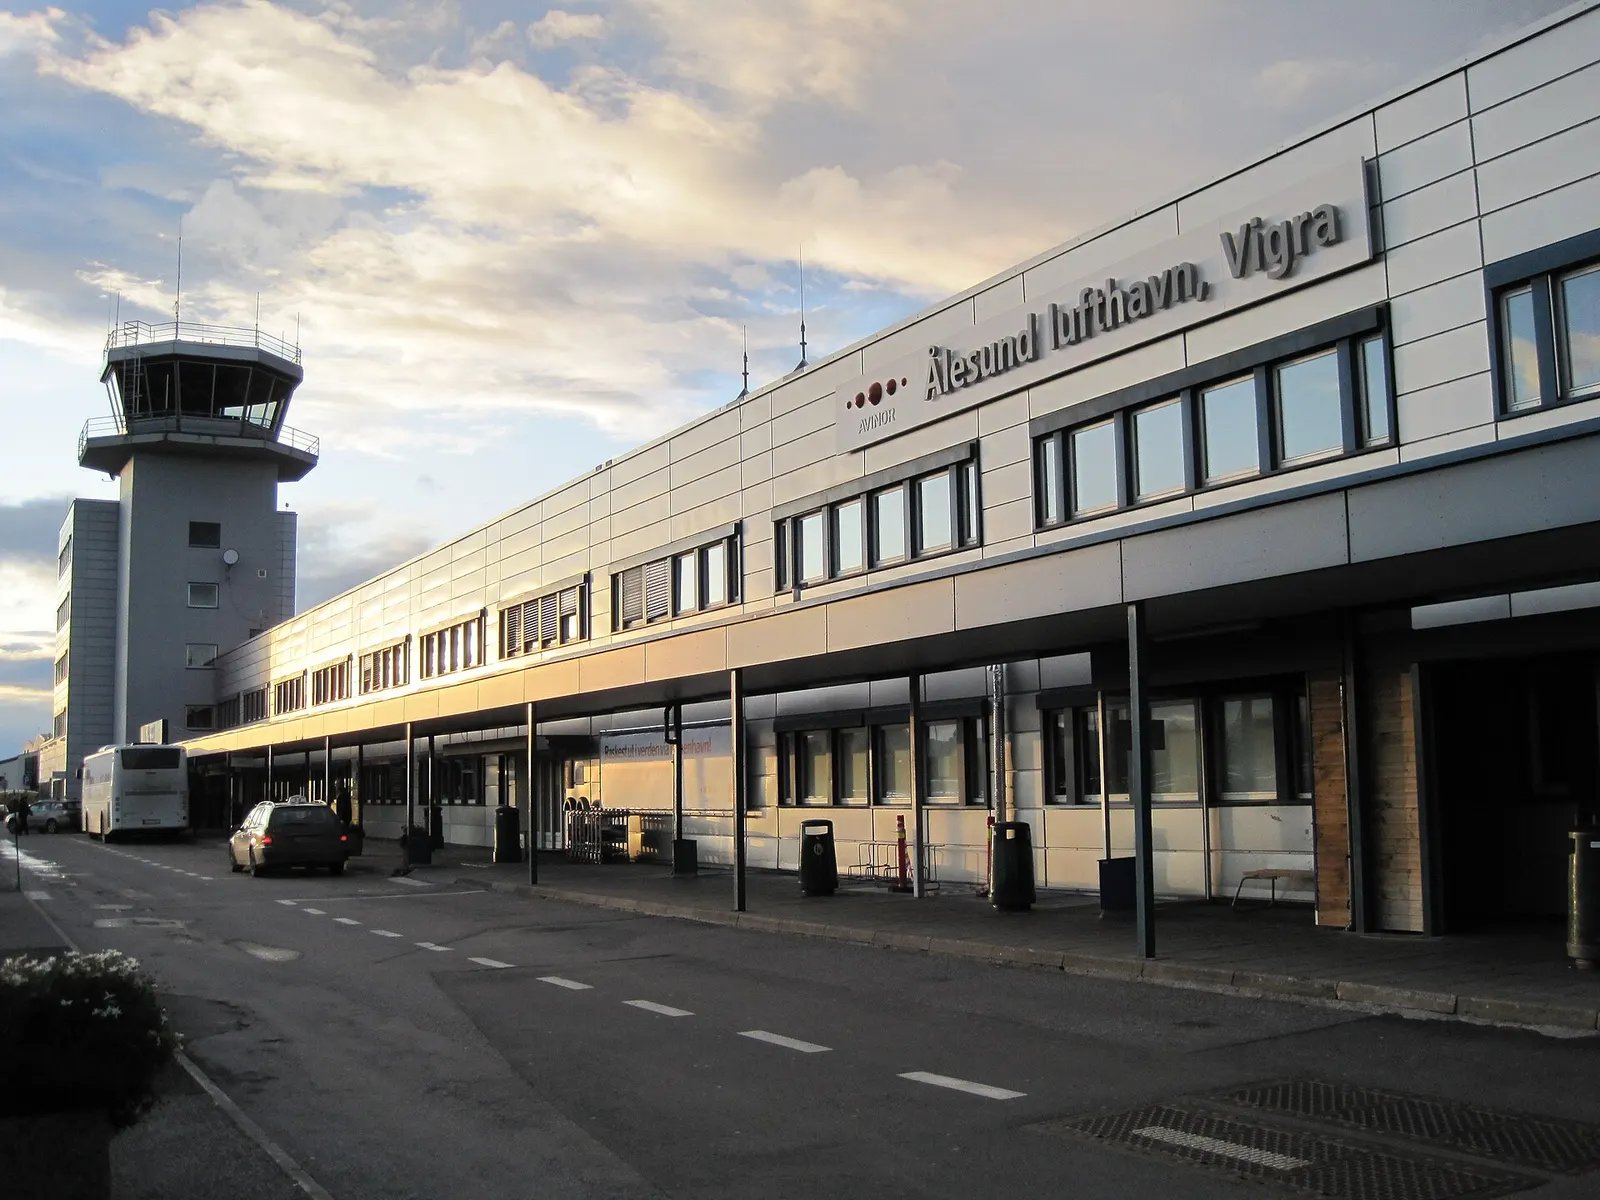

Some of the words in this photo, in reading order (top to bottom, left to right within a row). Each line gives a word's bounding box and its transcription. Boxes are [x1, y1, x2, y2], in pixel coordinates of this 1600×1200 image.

[924, 313, 1037, 401] Ålesund
[1047, 261, 1212, 351] lufthavn,
[1220, 203, 1342, 279] Vigra
[858, 408, 896, 434] AVINOR
